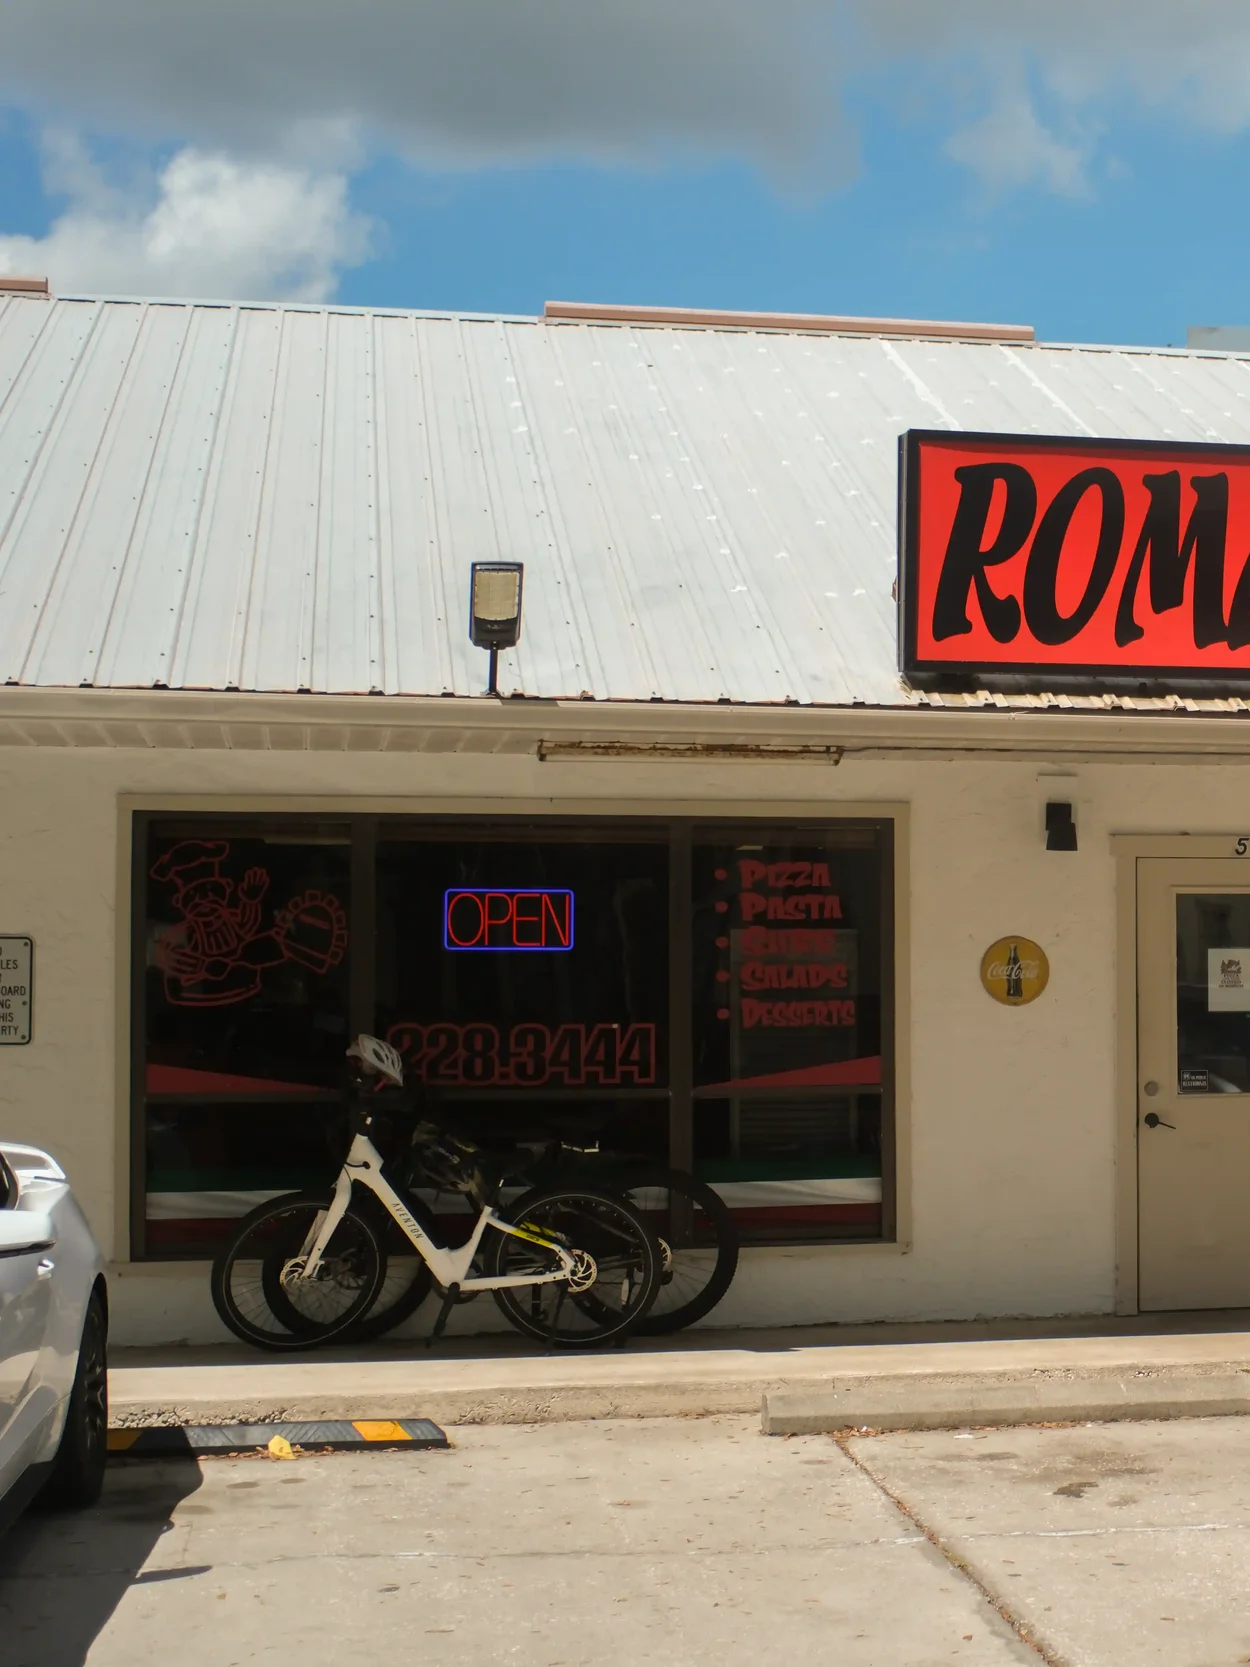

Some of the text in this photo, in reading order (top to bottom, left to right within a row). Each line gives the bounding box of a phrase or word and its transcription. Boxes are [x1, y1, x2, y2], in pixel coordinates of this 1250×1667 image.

[1235, 837, 1250, 856] 5
[738, 859, 831, 888] PIZZA
[448, 892, 570, 946] OPEN
[739, 892, 843, 921] PASTA
[740, 961, 848, 991] SALADS
[741, 998, 856, 1028] DESSERTS
[391, 1203, 424, 1239] AVENTON
